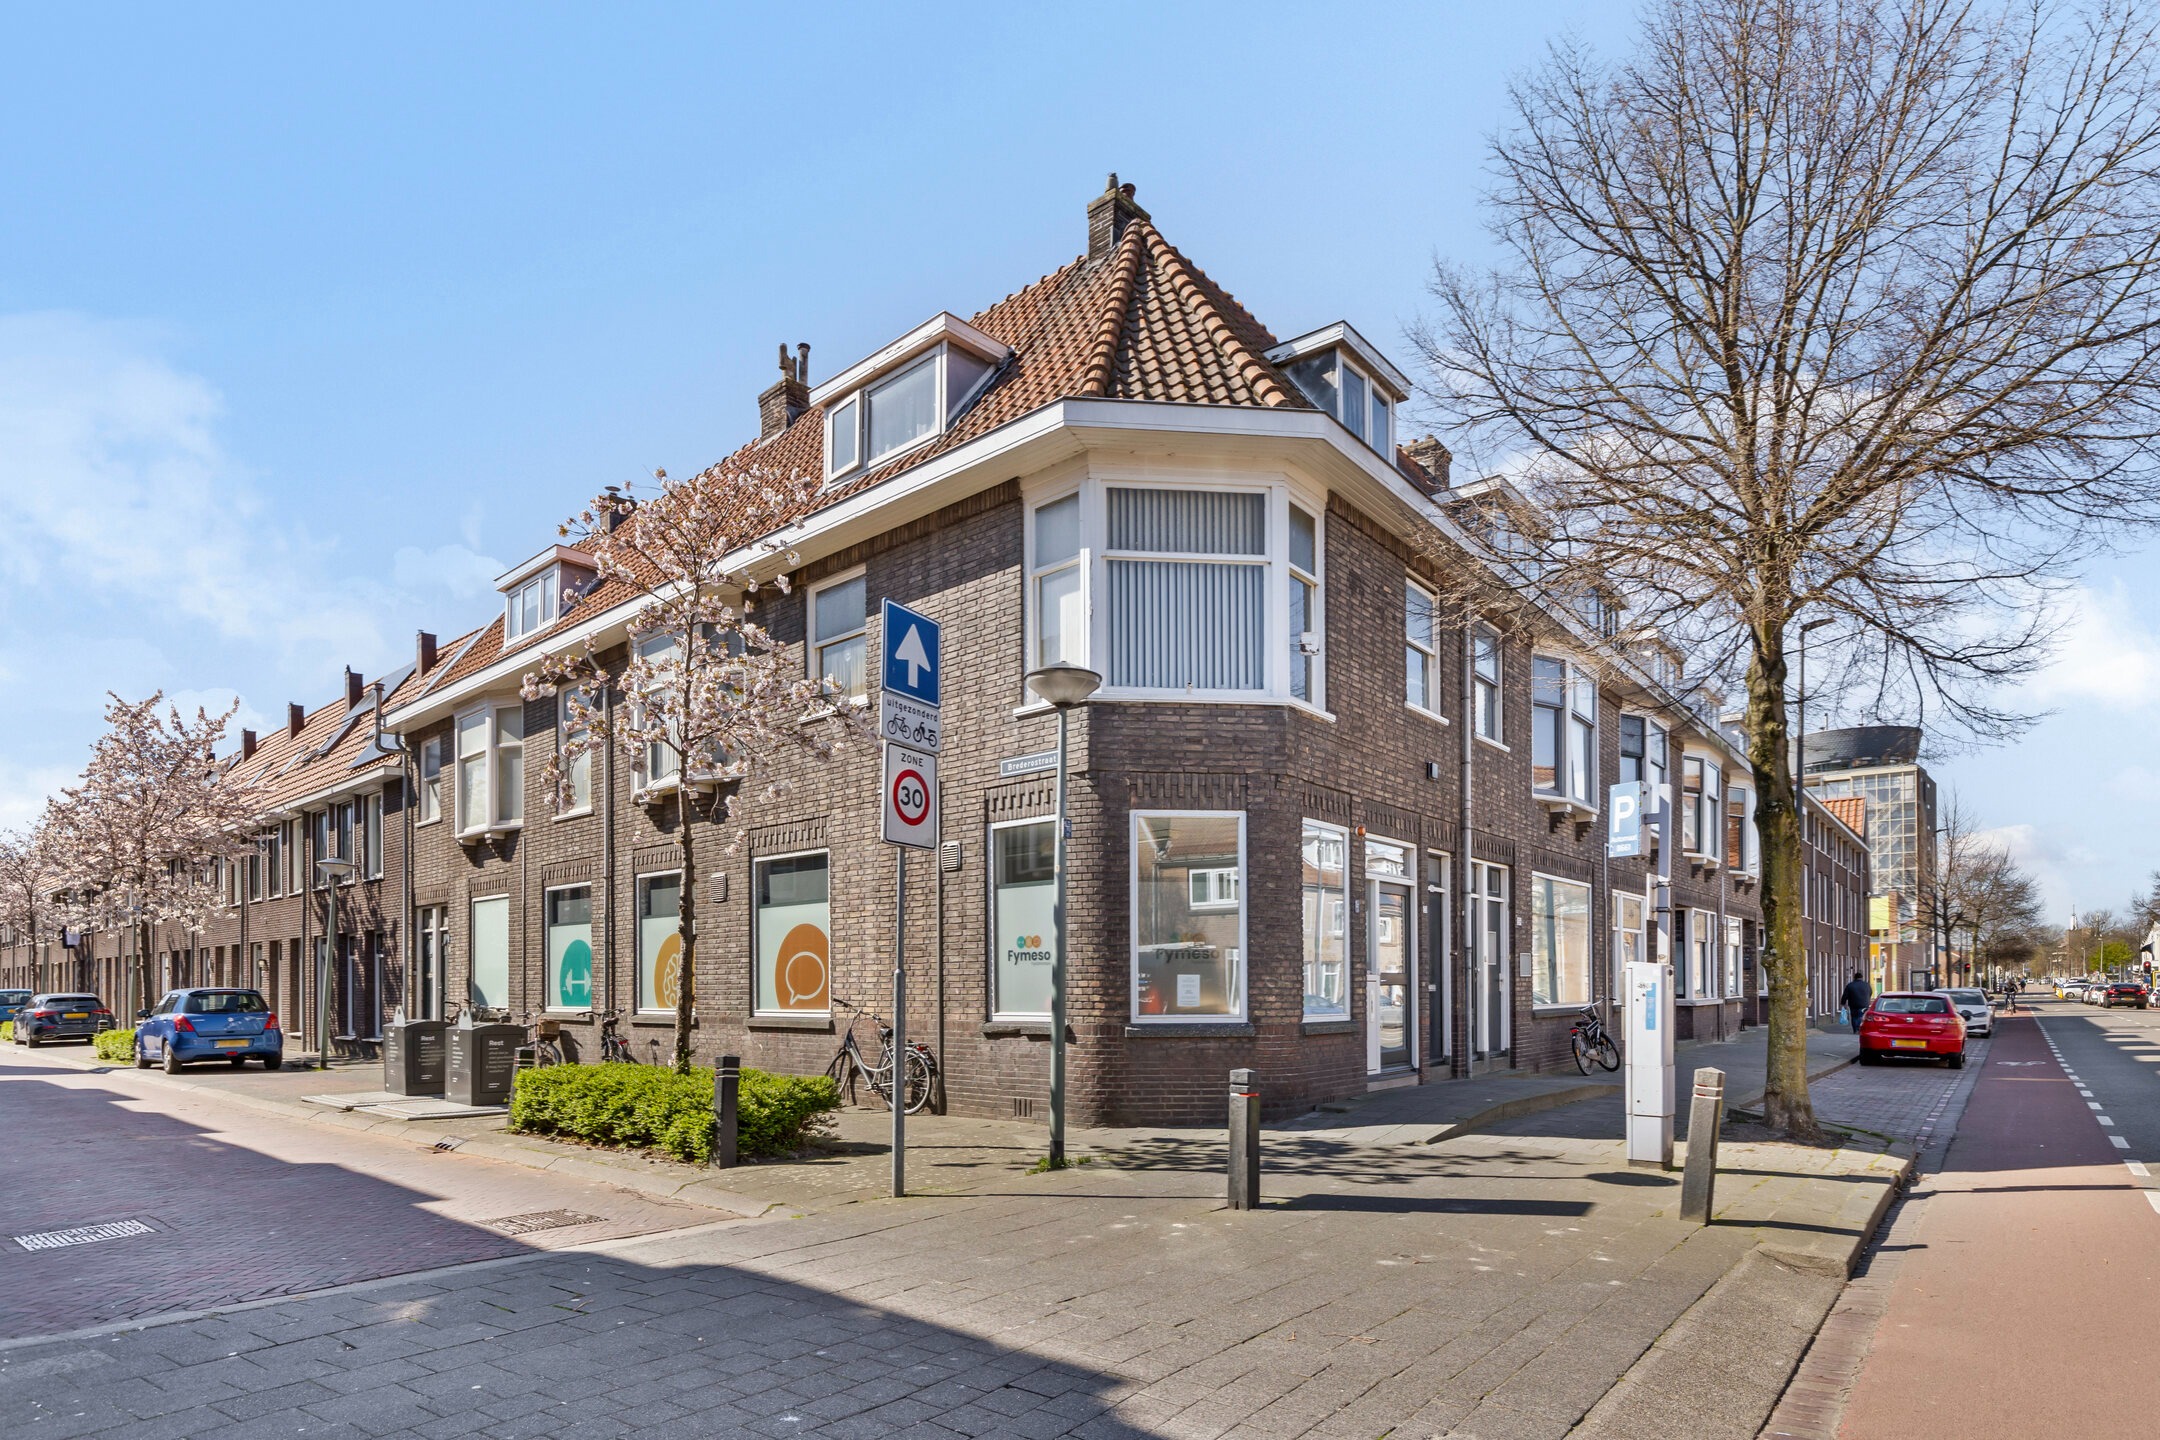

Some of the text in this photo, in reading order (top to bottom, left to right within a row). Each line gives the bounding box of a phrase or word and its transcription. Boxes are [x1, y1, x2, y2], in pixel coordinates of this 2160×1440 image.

[886, 698, 938, 722] uitgezonderd
[901, 752, 924, 767] ZONE
[1007, 755, 1057, 771] Brederostraat
[900, 785, 923, 809] 30
[1613, 795, 1636, 833] P
[1007, 949, 1052, 966] Fymeso
[1155, 948, 1220, 964] Fymeso
